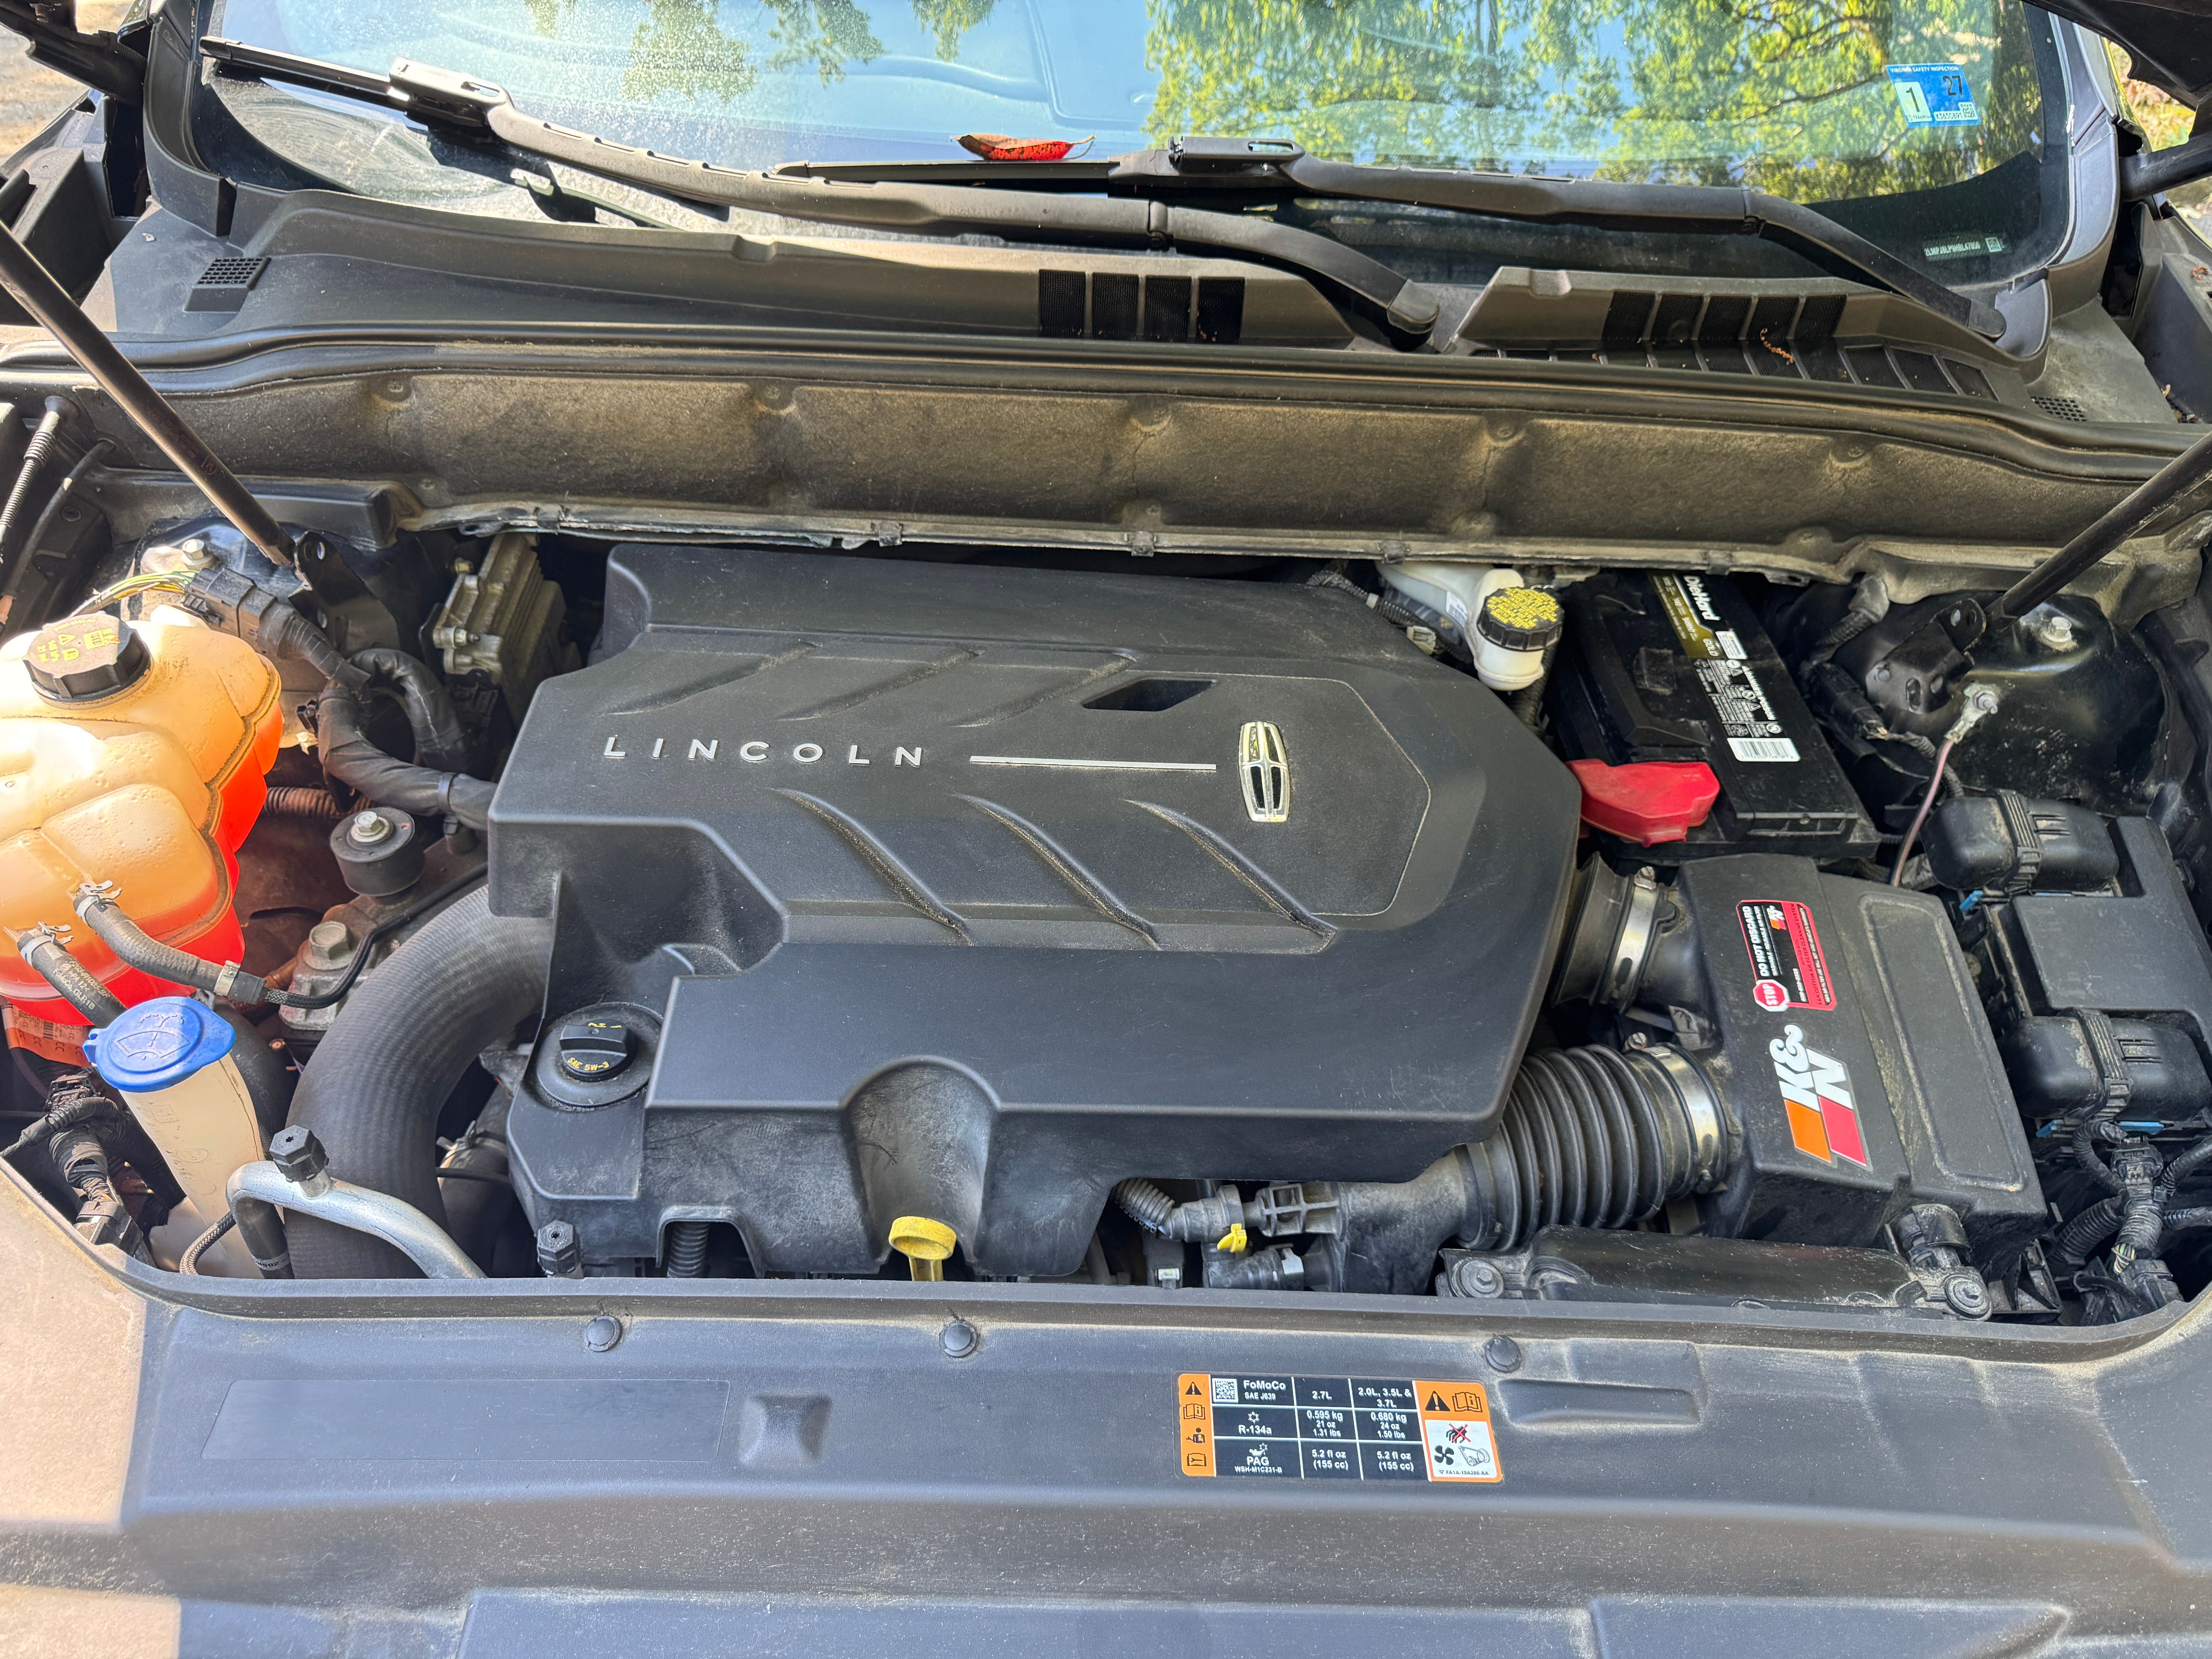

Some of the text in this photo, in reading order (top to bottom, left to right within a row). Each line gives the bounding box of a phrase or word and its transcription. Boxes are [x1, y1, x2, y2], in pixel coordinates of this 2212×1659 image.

[1942, 75, 1963, 96] 27
[1906, 87, 1920, 112] 1
[1683, 575, 1722, 621] DieHard
[603, 737, 922, 766] LINCOLN
[1790, 903, 1800, 922] SYSTEM
[1797, 923, 1807, 946] CLEANING
[1742, 906, 1770, 977] DO NOT DISCARD
[1803, 947, 1811, 963] FILTER
[1810, 973, 1819, 993] COTTON
[1762, 983, 1778, 1006] STOP
[567, 1057, 583, 1069] SAE
[1769, 1024, 1853, 1110] K&N
[1243, 1380, 1286, 1391] FoMoCo
[1245, 1392, 1276, 1401] SAE J639
[1312, 1390, 1333, 1400] 2.7L
[1358, 1387, 1413, 1398] 2.0L, 3.5L &
[1377, 1399, 1397, 1408] 3.7L
[1307, 1410, 1343, 1423] 0.595 kg
[1370, 1412, 1407, 1425] 0.680 kg
[1238, 1425, 1272, 1436] R-134a
[1316, 1420, 1325, 1429] 21
[1380, 1422, 1401, 1431] 24 oz
[1313, 1428, 1341, 1438] 1.31 lbs
[1377, 1430, 1406, 1439] 1.50 lbs
[1312, 1449, 1347, 1460] 5.2 fl oz
[1377, 1451, 1412, 1461] 5.2 fl oz
[1247, 1456, 1269, 1466] PAG
[1313, 1459, 1349, 1472] (155 cc)
[1379, 1461, 1414, 1473] (155 cc)
